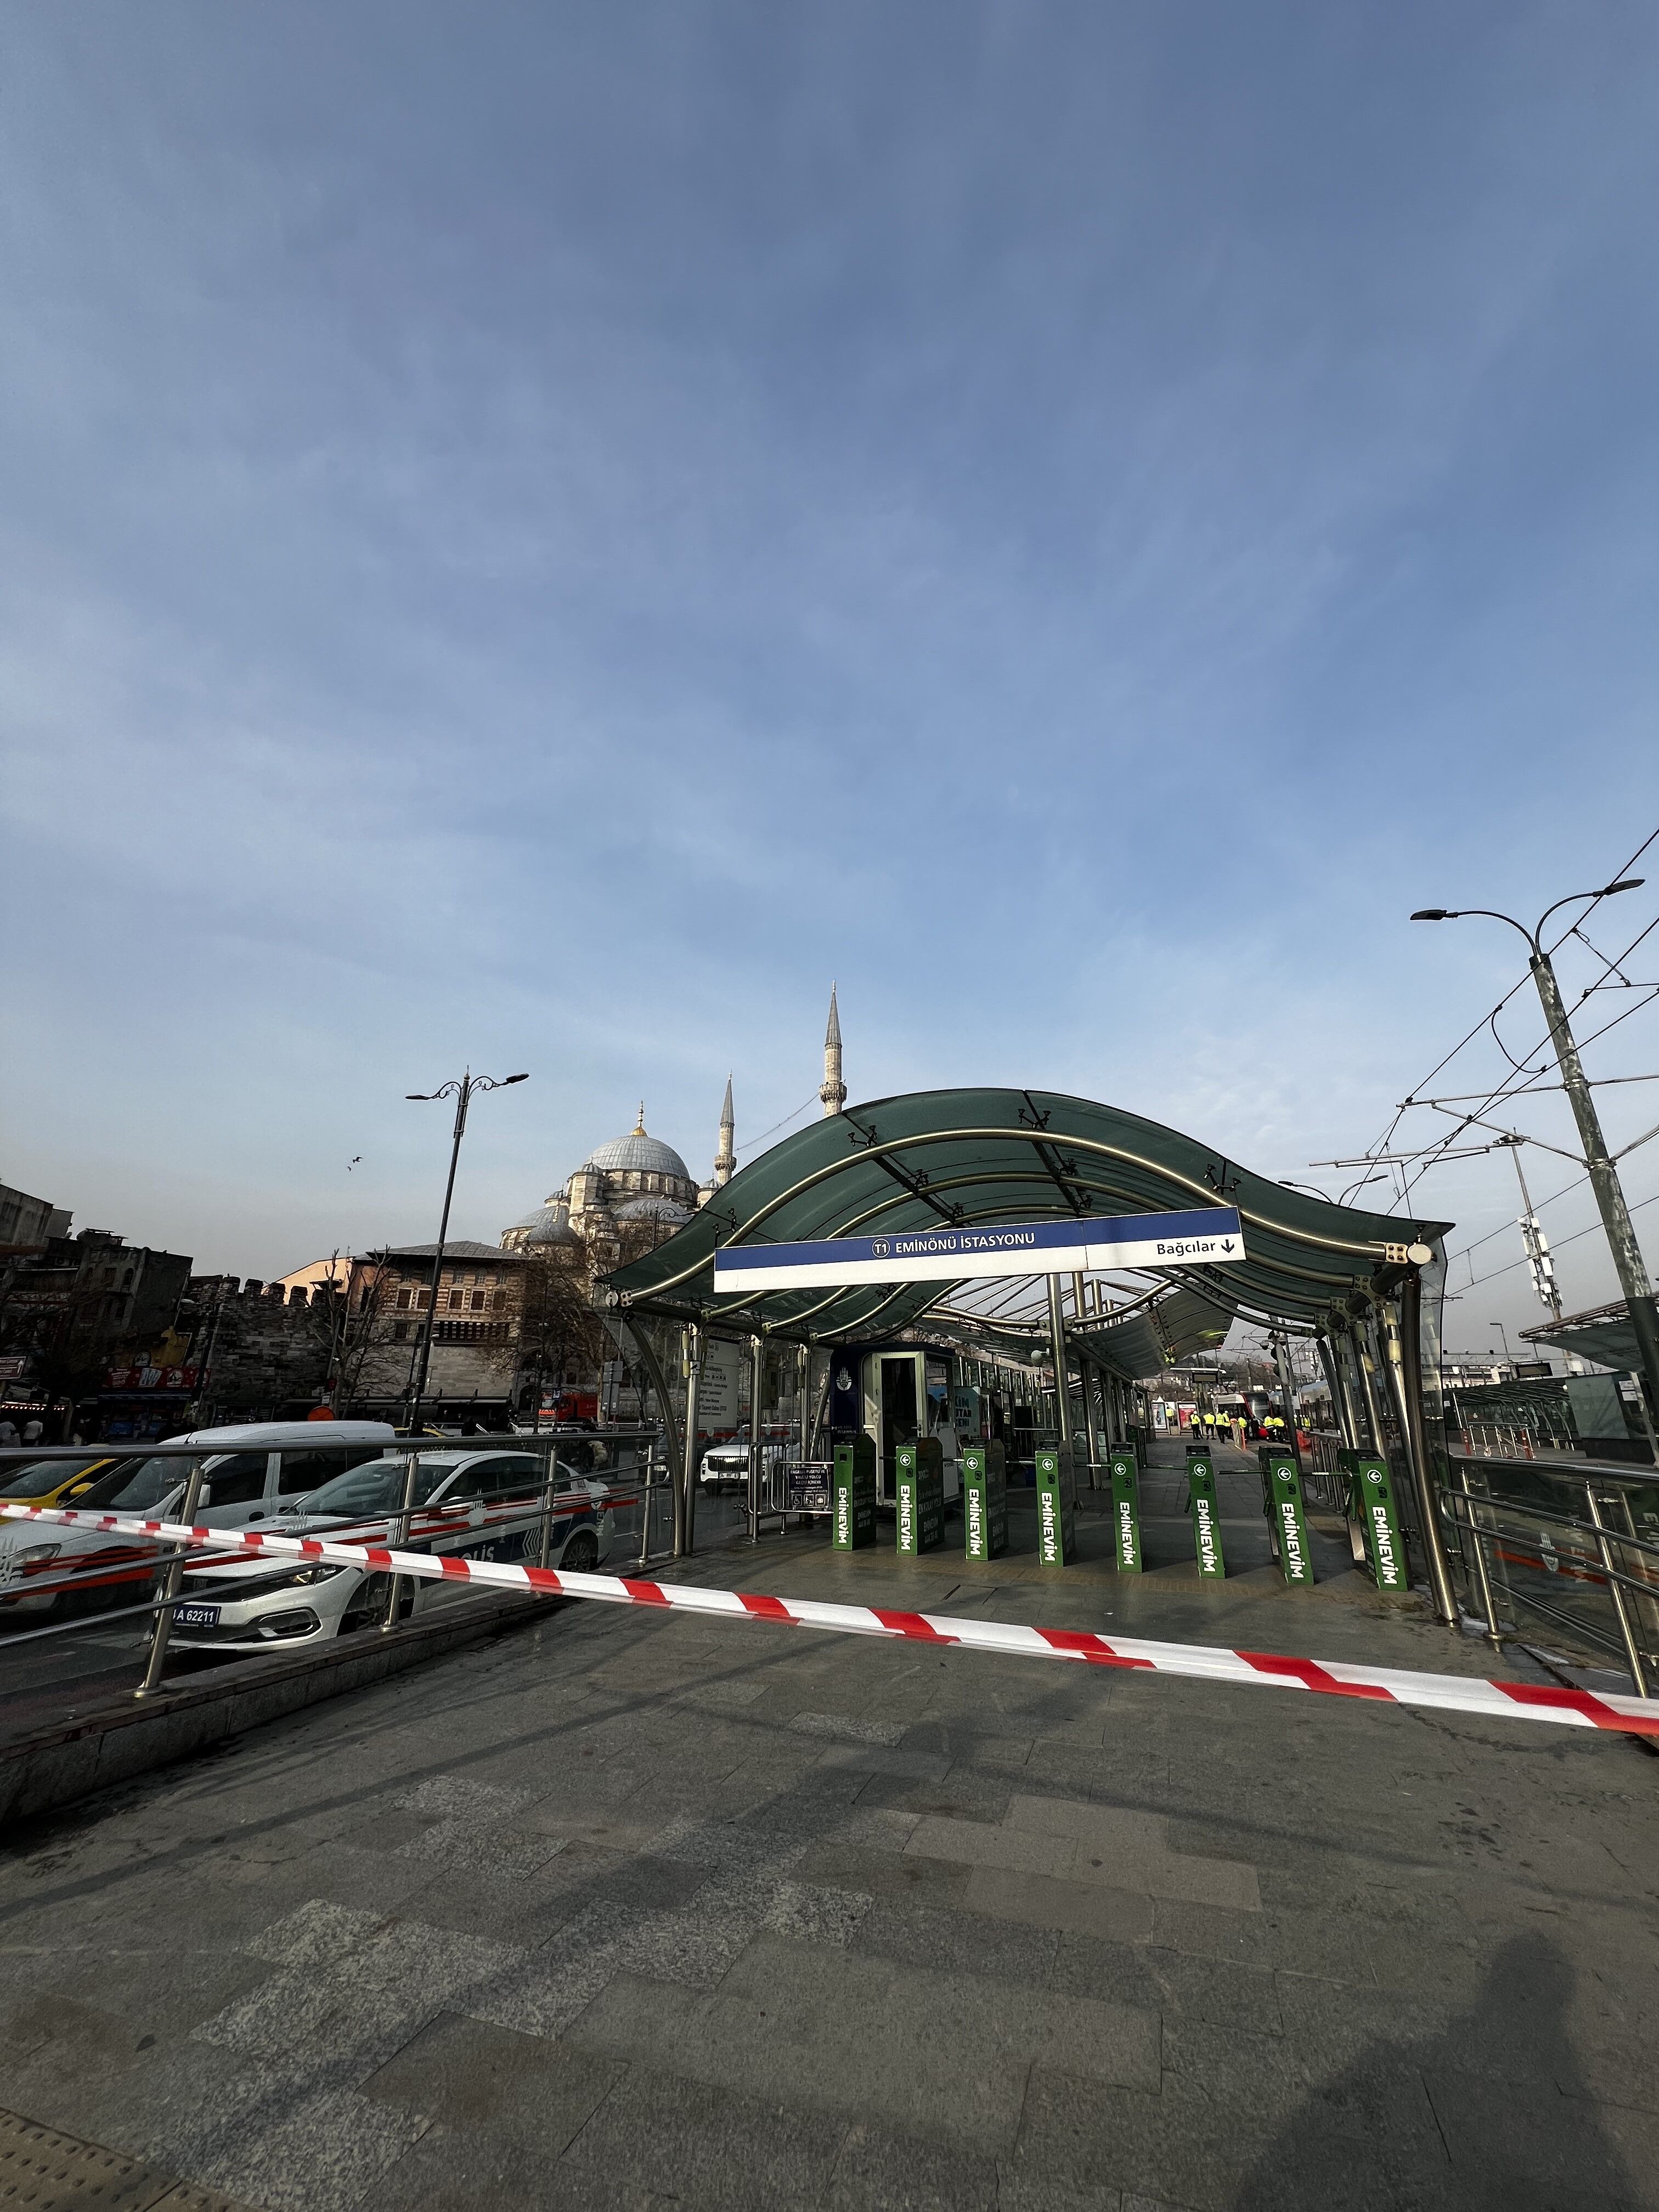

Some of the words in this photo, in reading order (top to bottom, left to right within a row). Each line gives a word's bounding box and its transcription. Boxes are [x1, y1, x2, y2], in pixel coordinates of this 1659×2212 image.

[874, 1242, 888, 1254] T1
[895, 1236, 957, 1253] EMİNÖNÜ
[961, 1232, 1035, 1249] İSTASYONU
[1157, 1240, 1216, 1256] Bağcılar
[838, 1487, 849, 1544] EMİNEVİM
[901, 1485, 913, 1550] EMİNEVİM
[969, 1489, 983, 1555] EMİNEVİM
[1041, 1492, 1057, 1561] EMİNEVİM
[1119, 1502, 1135, 1566] EMİNEVİM
[1197, 1499, 1218, 1573] EMİNEVİM
[1281, 1503, 1305, 1579] EMİNEVİM
[1372, 1506, 1398, 1585] EMİNEVİM
[187, 1610, 214, 1622] 62211
